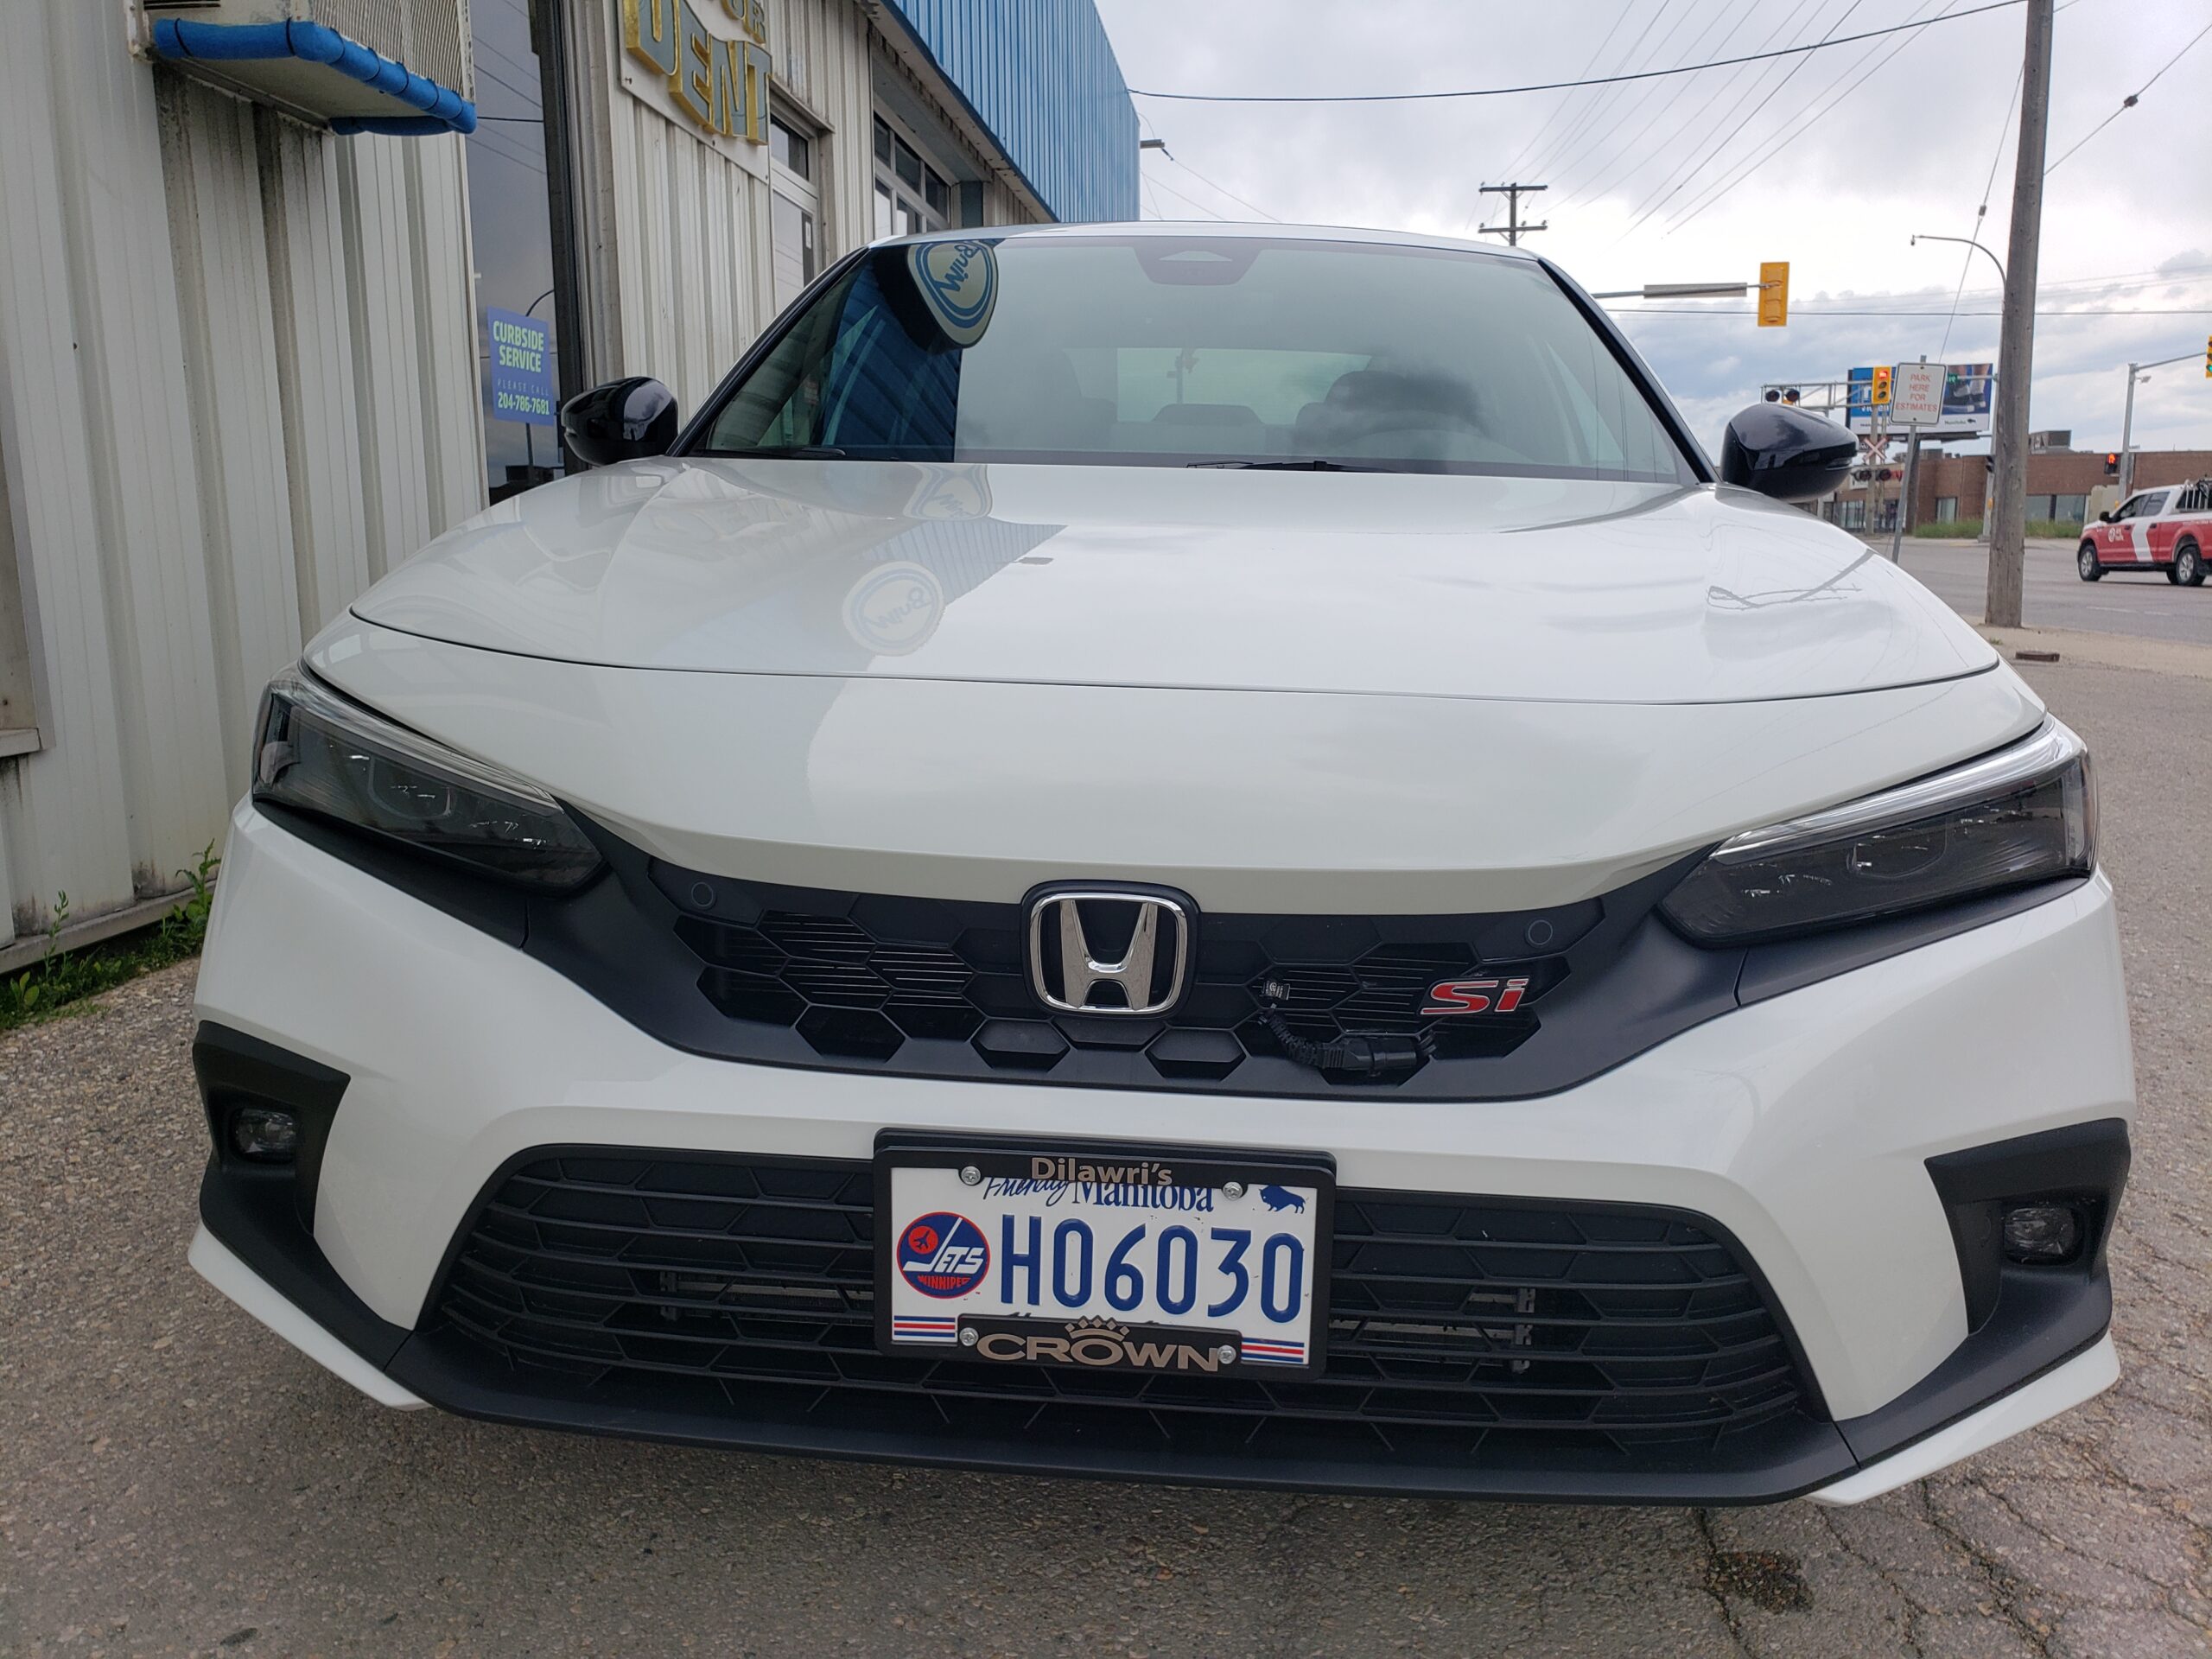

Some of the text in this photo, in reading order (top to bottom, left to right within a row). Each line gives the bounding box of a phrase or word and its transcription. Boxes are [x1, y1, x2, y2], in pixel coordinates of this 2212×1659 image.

[493, 321, 544, 352] CURBSIDE
[499, 345, 542, 372] SERVICE
[497, 378, 550, 397] PLEASE CALL
[1909, 384, 1929, 392] HERE
[1910, 373, 1931, 382] PARK
[498, 391, 550, 416] 204-786-7681
[1895, 402, 1937, 412] ESTIMATES
[1420, 978, 1529, 1015] Si
[1031, 1157, 1173, 1186] Dilawri's
[902, 1217, 985, 1274] JETS
[976, 1332, 1218, 1372] CROWN
